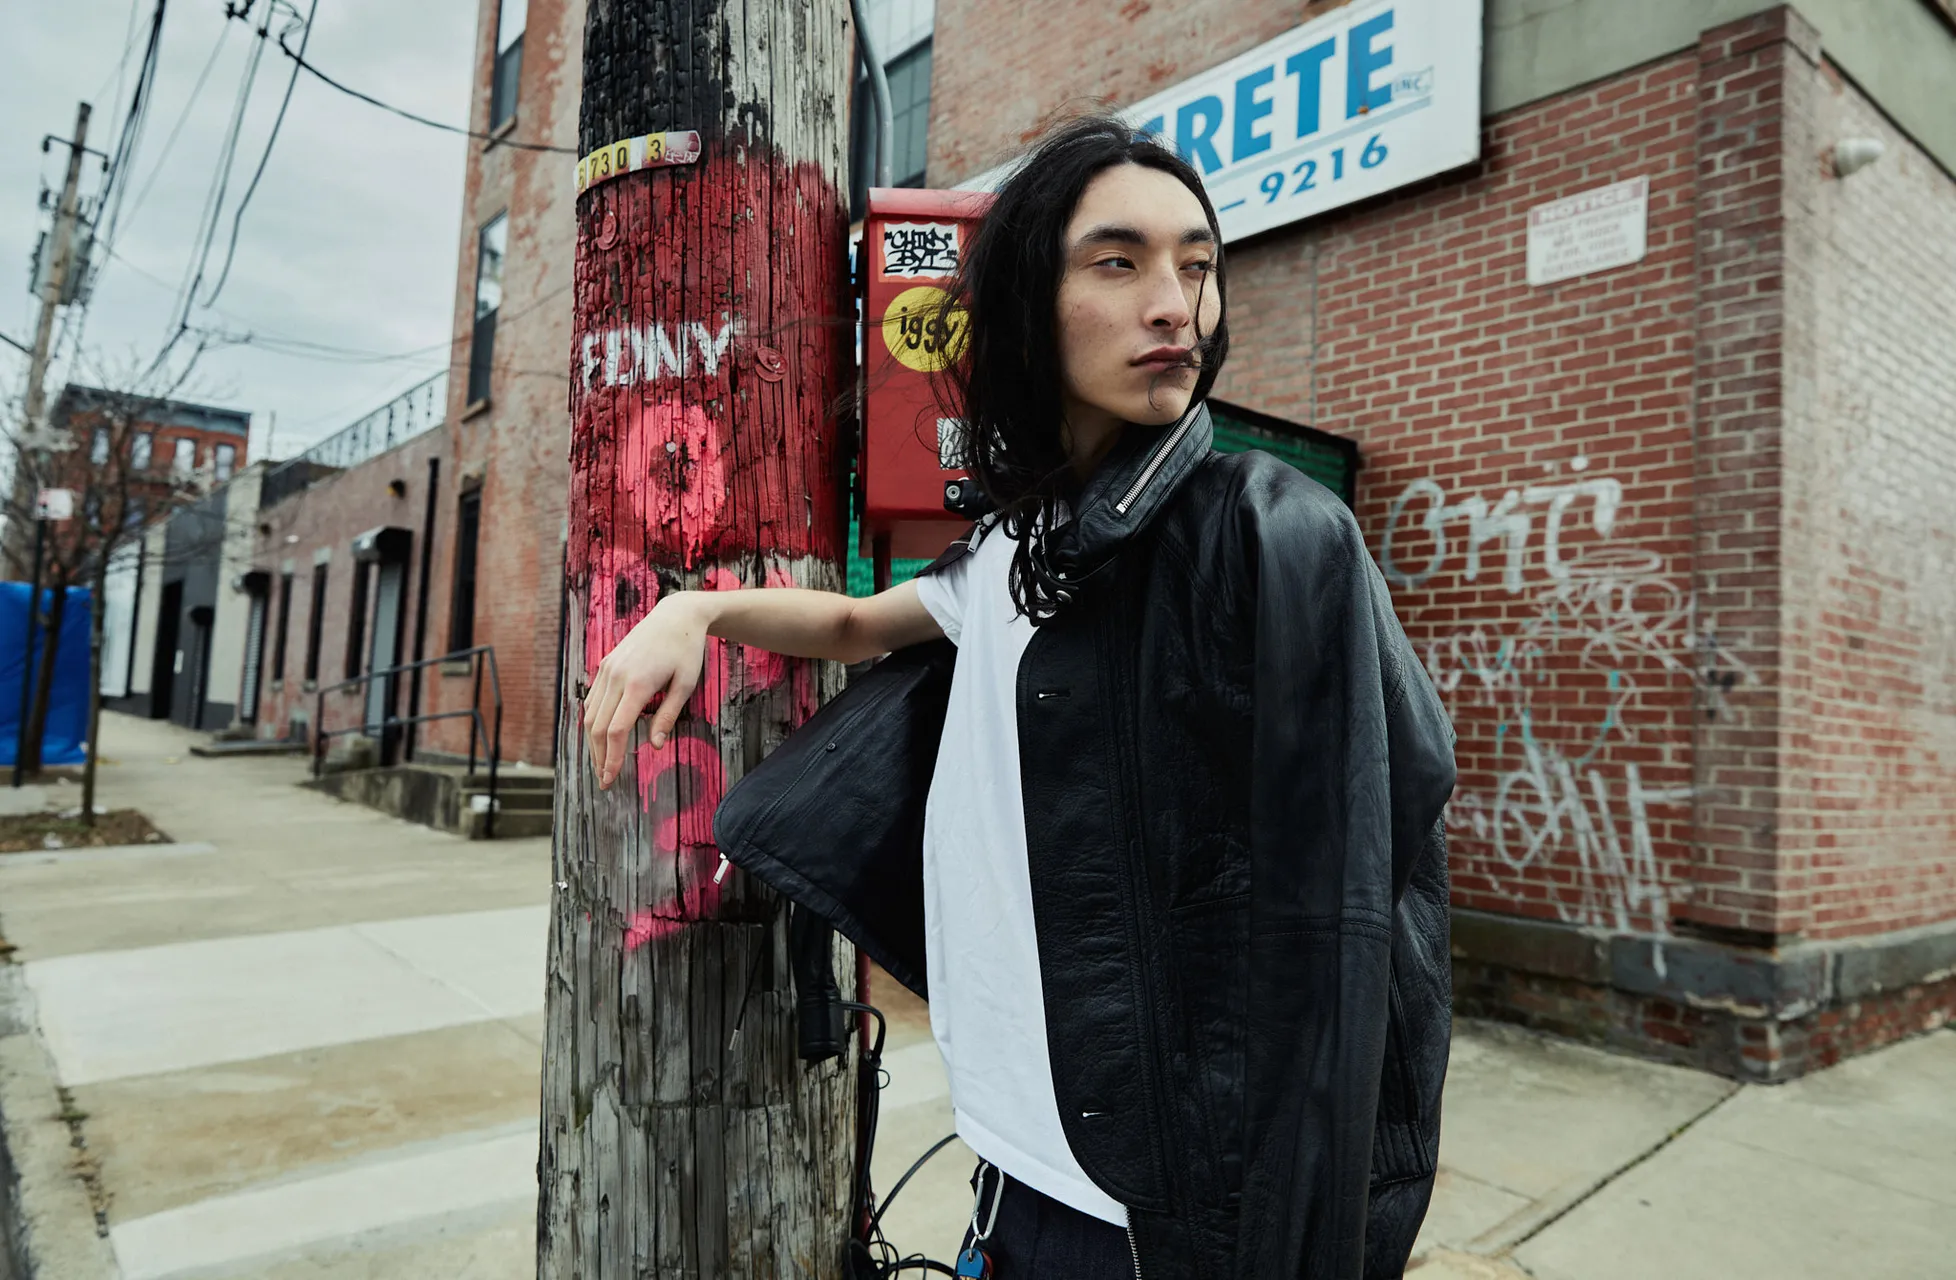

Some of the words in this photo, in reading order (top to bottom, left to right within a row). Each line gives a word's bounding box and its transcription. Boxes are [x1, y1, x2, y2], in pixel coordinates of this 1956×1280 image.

[650, 139, 661, 162] 3
[1539, 188, 1632, 223] NOTICE
[899, 306, 959, 354] iggy
[580, 321, 734, 391] FDNY
